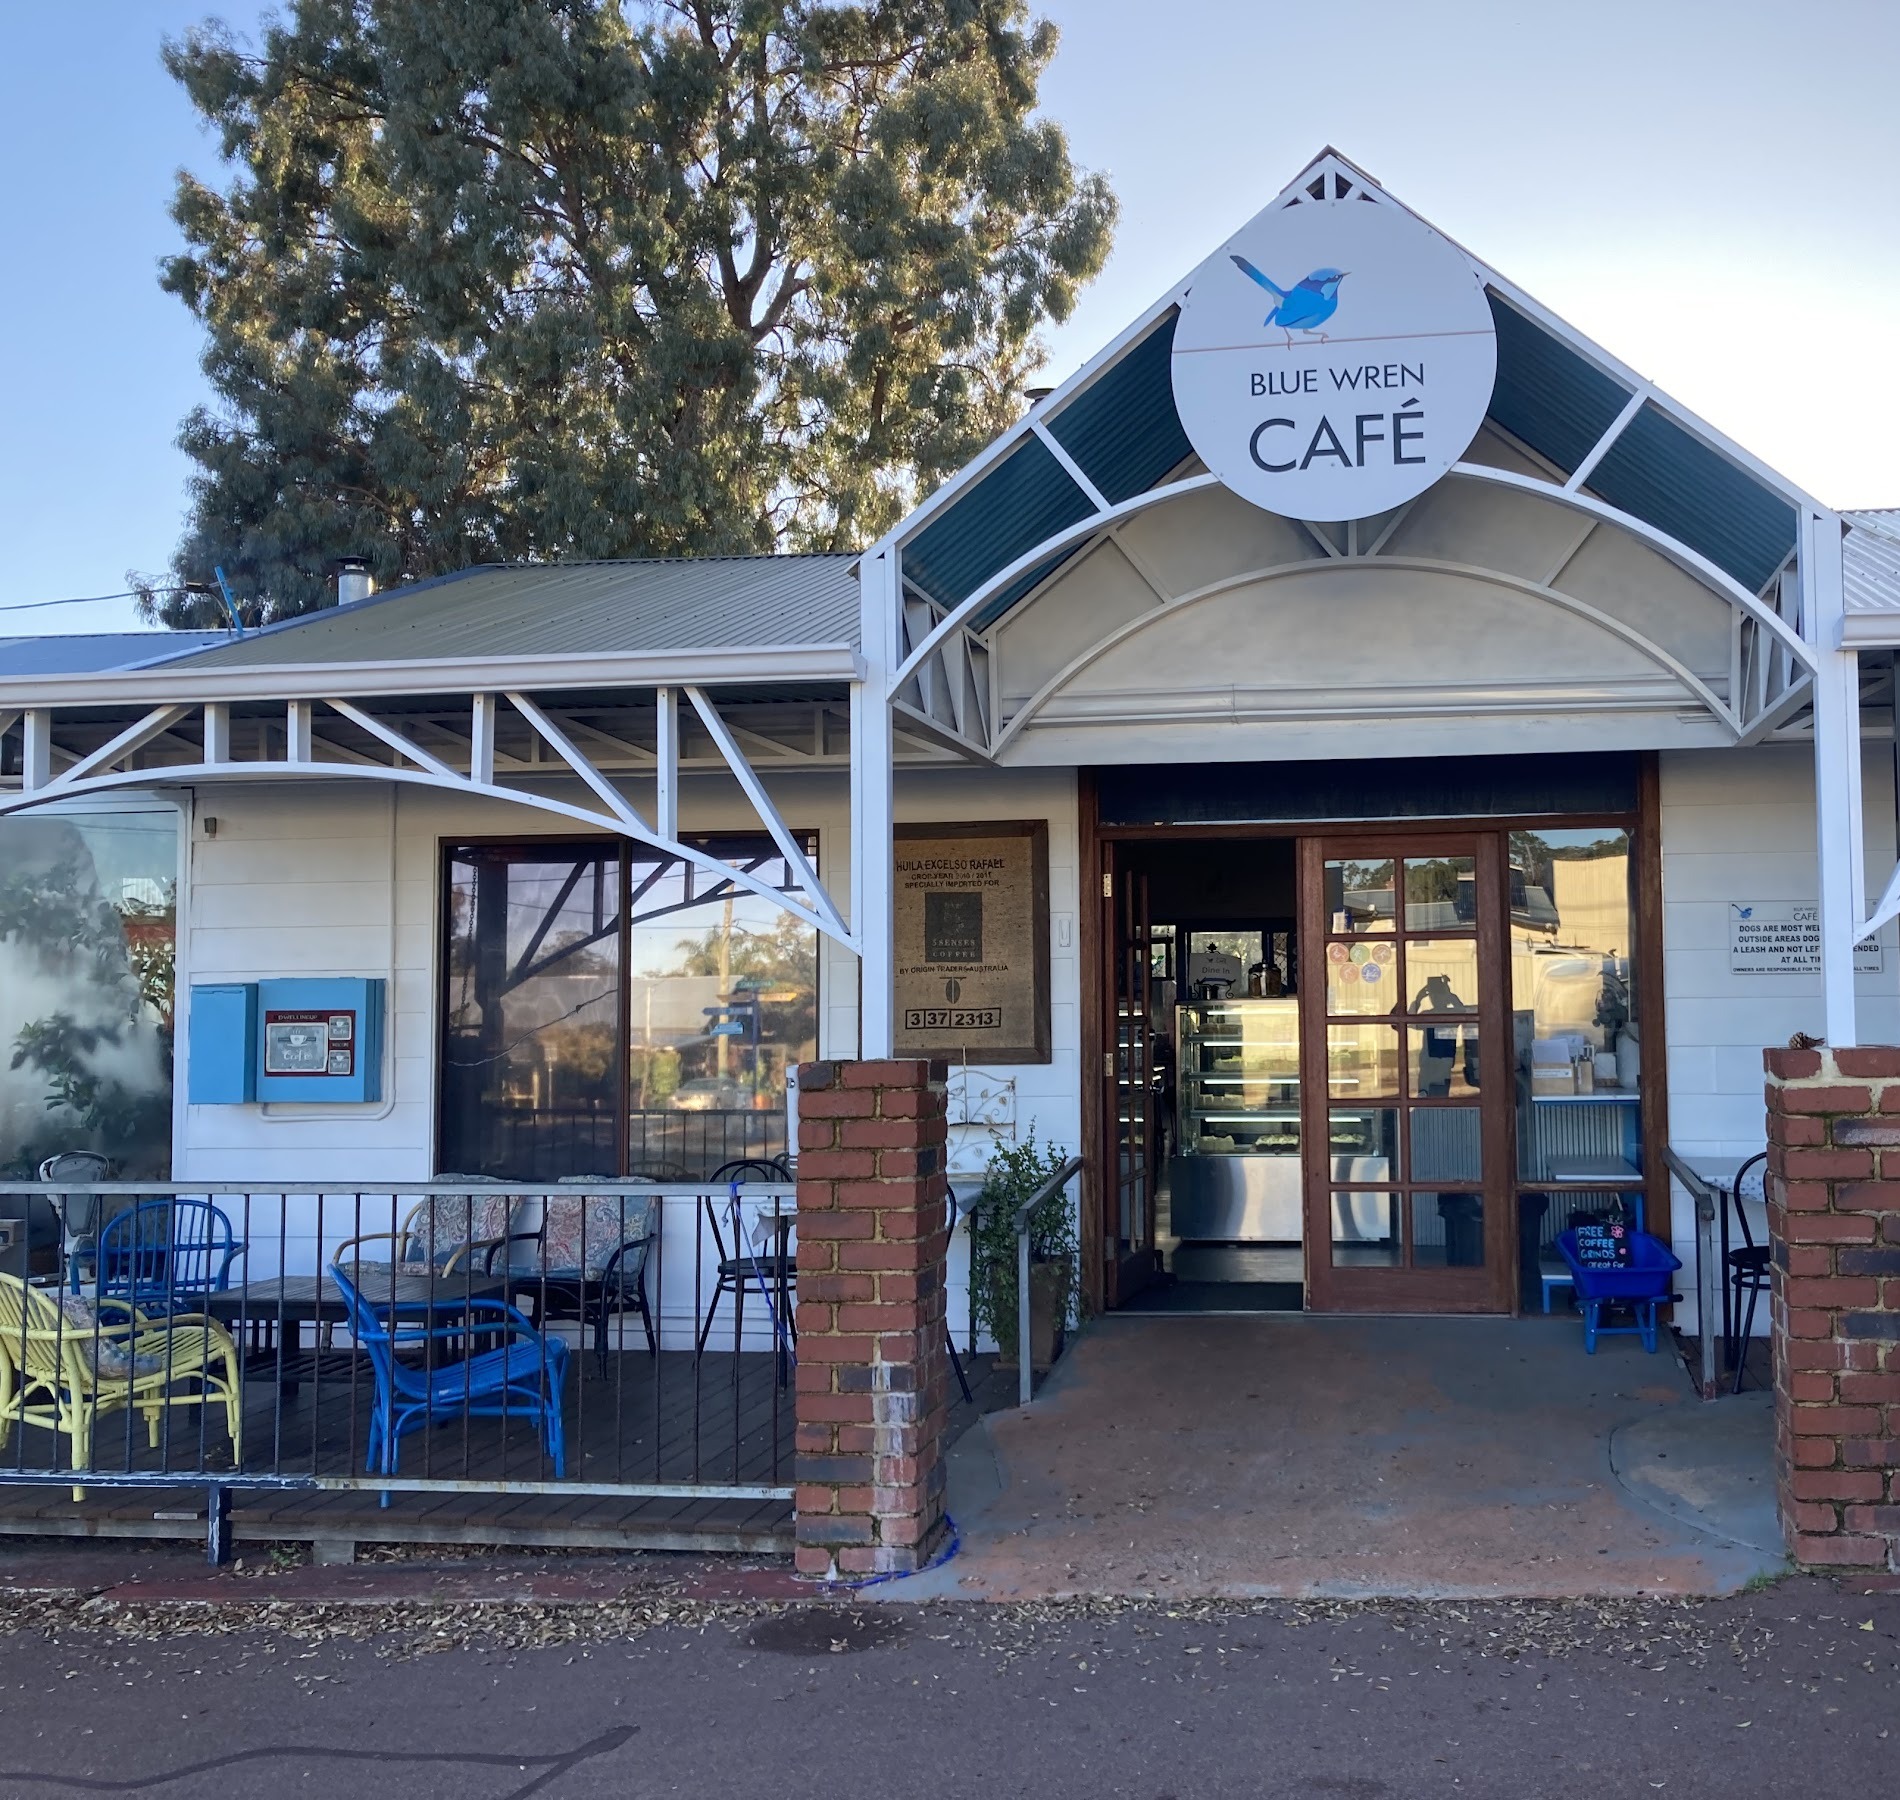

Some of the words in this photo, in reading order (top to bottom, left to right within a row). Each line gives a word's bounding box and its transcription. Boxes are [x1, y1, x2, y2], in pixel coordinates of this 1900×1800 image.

[1250, 369, 1318, 396] BLUE
[1328, 363, 1424, 391] WREN
[1249, 397, 1426, 473] CAFÉ
[896, 860, 922, 872] HUILA
[925, 859, 968, 870] EXCELSO
[970, 858, 1005, 870] RAFAEL
[904, 881, 943, 889] SPECIALLY
[946, 880, 982, 888] IMPORTED
[1780, 924, 1802, 932] MOST
[1781, 956, 1791, 964] AT
[910, 966, 935, 974] ORIGIN
[1202, 966, 1220, 974] Dine
[910, 1012, 921, 1026] 3
[927, 1012, 948, 1026] 37
[954, 1012, 994, 1026] 2313
[1578, 1226, 1604, 1237] FREE
[1579, 1238, 1614, 1248] COFFEE
[1580, 1248, 1616, 1259] GRINDS
